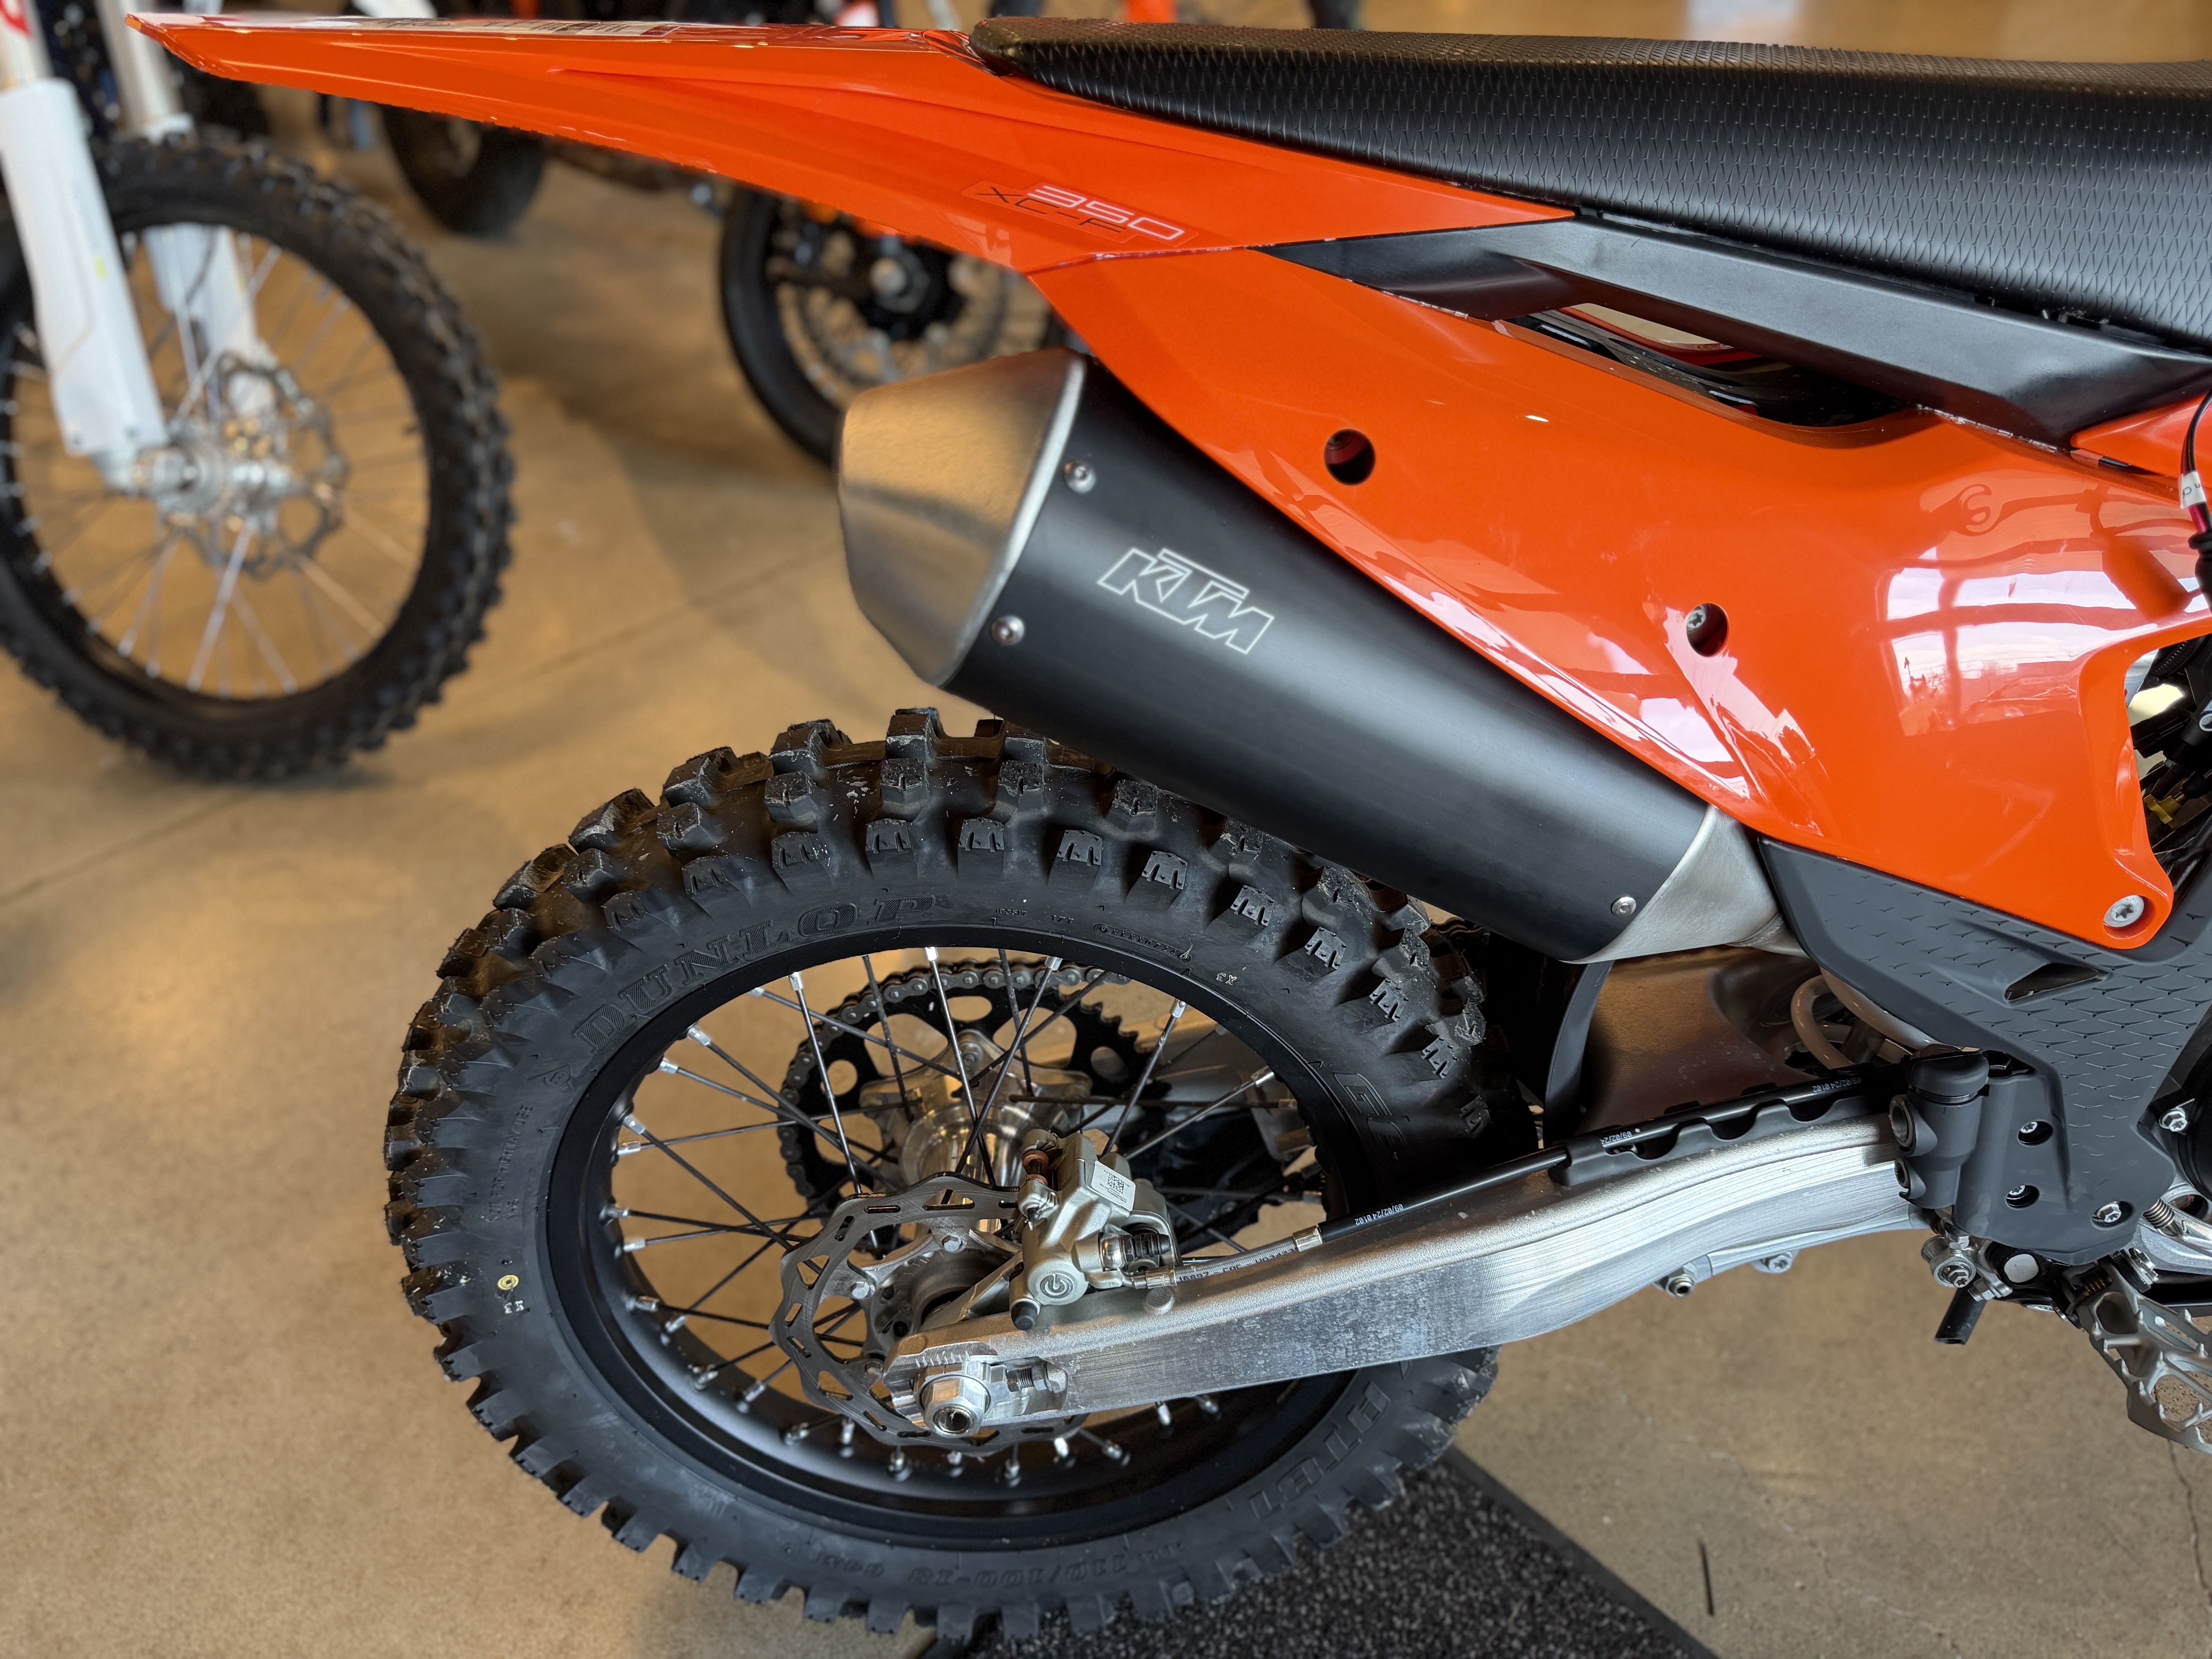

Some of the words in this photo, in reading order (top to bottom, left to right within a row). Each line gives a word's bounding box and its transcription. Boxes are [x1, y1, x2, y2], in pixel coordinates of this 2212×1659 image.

[976, 186, 1128, 233] XC-F
[1027, 185, 1185, 240] 350
[1097, 548, 1274, 655] KTM
[572, 893, 937, 1054] DUNLOP
[1372, 1203, 1404, 1220] 09/02/24
[1249, 1381, 1390, 1518] AT81
